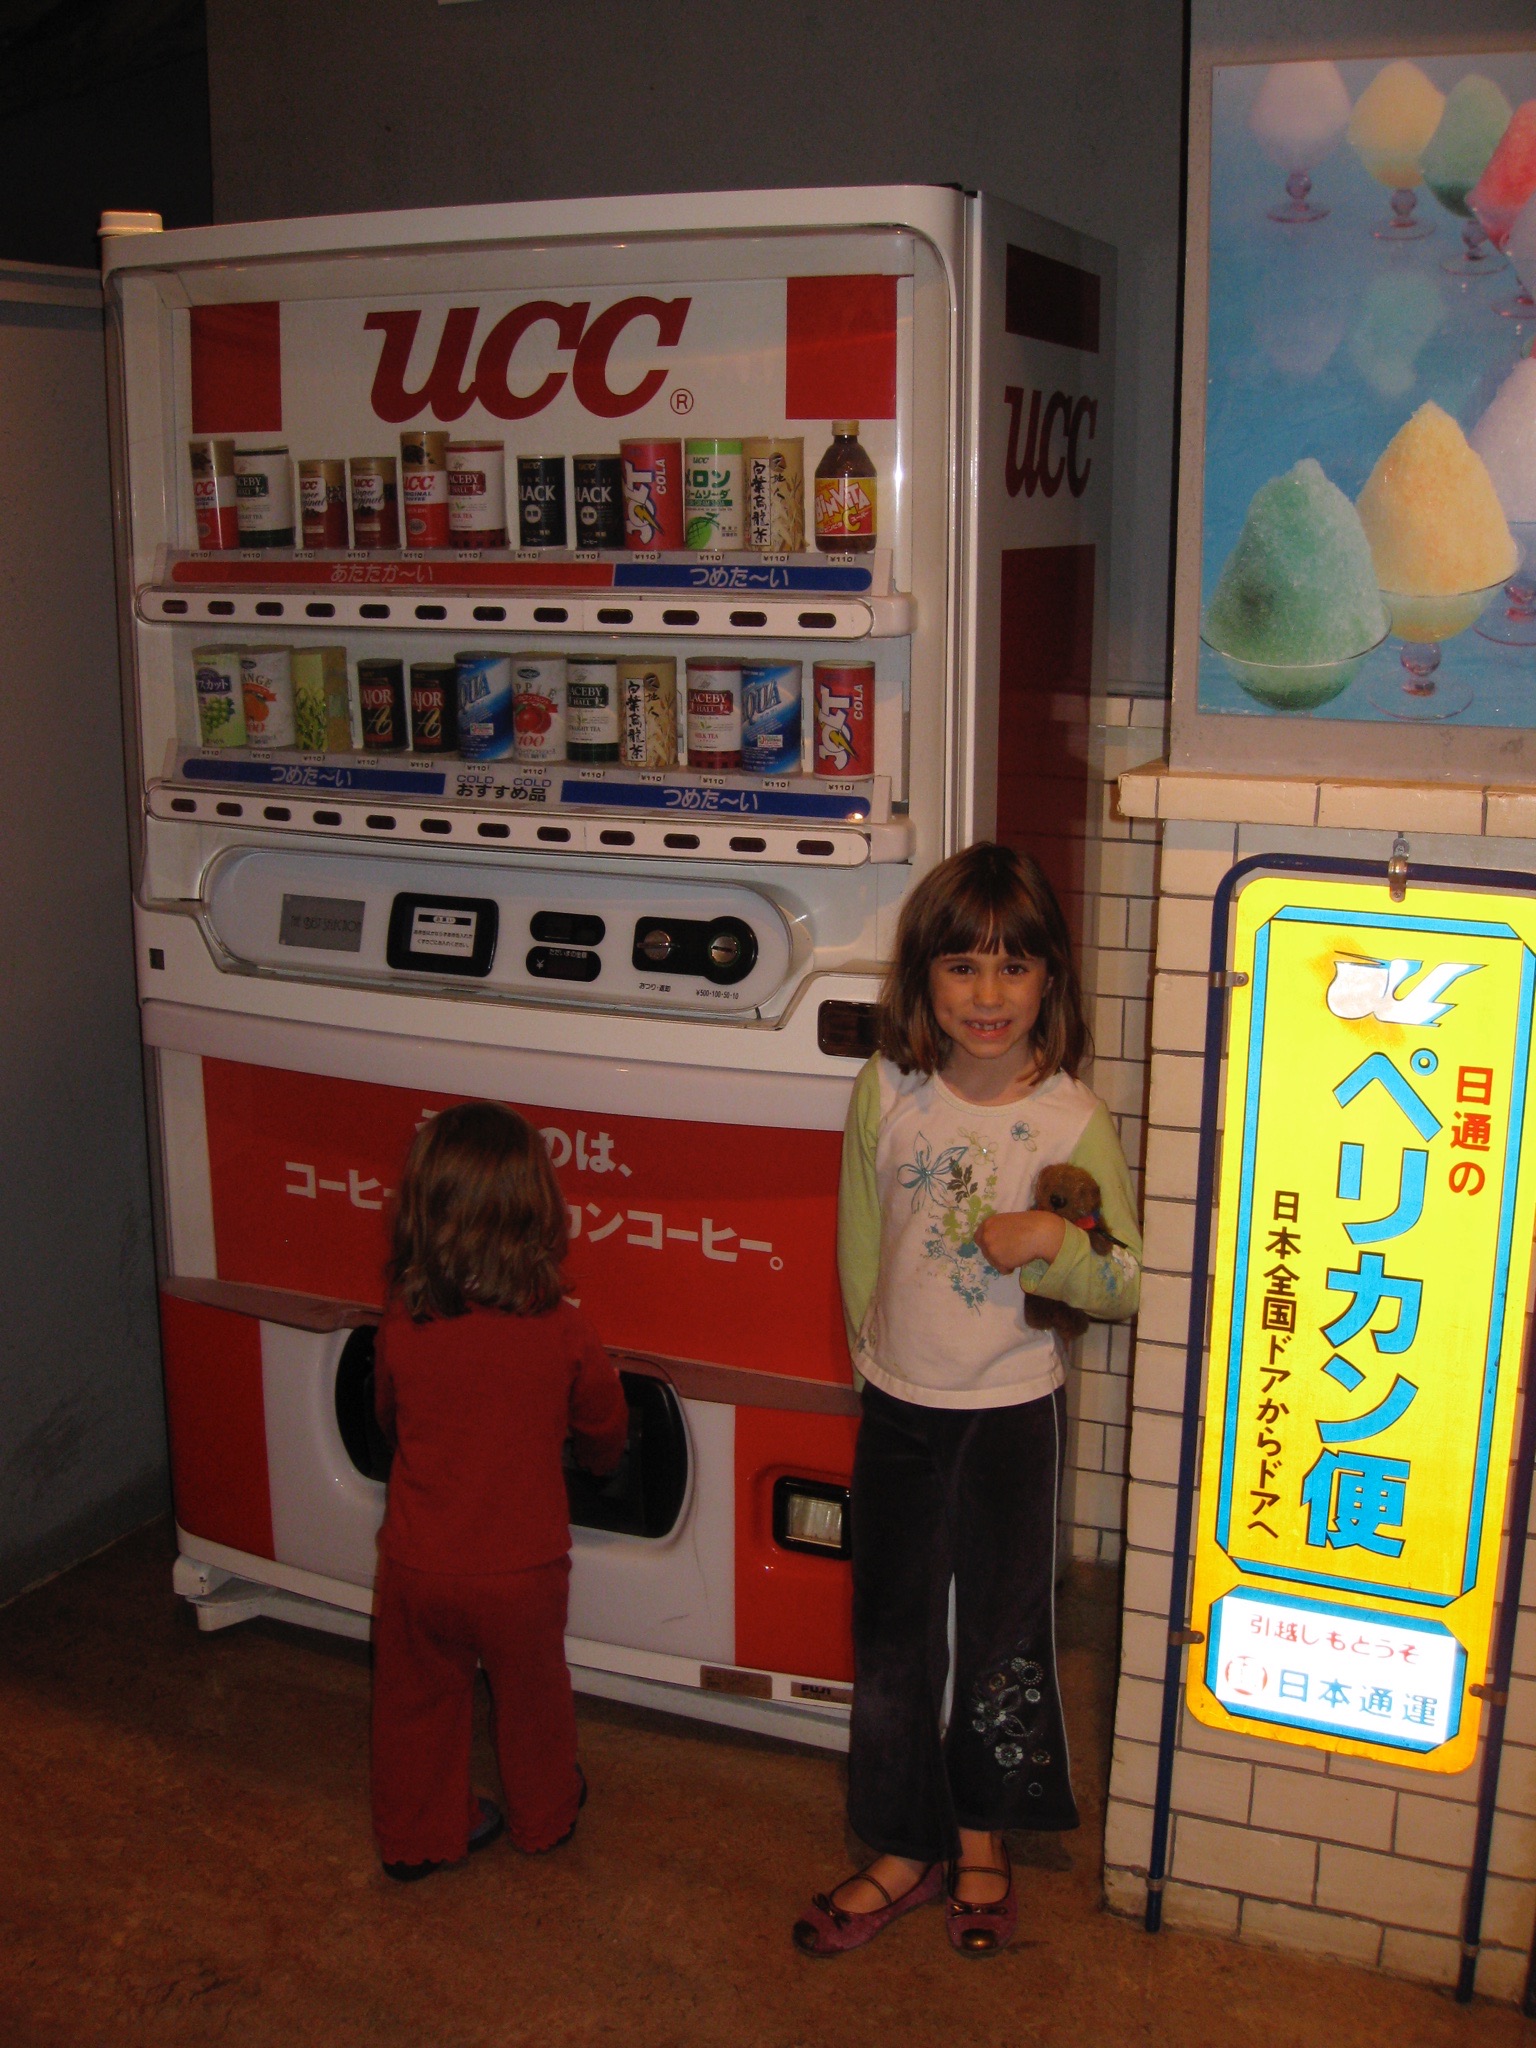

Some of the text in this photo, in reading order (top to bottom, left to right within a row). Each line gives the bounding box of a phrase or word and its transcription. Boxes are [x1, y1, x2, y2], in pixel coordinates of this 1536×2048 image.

[656, 459, 667, 495] COLA
[853, 684, 864, 721] COLA
[456, 783, 547, 802] おすすめ品
[457, 775, 552, 788] COLD COLD
[1448, 1065, 1494, 1197] 日通の
[1300, 1047, 1443, 1558] ペリカン便
[1247, 1190, 1302, 1539] 日本全国ドアからドアへ
[1278, 1668, 1438, 1727] 日本通運
